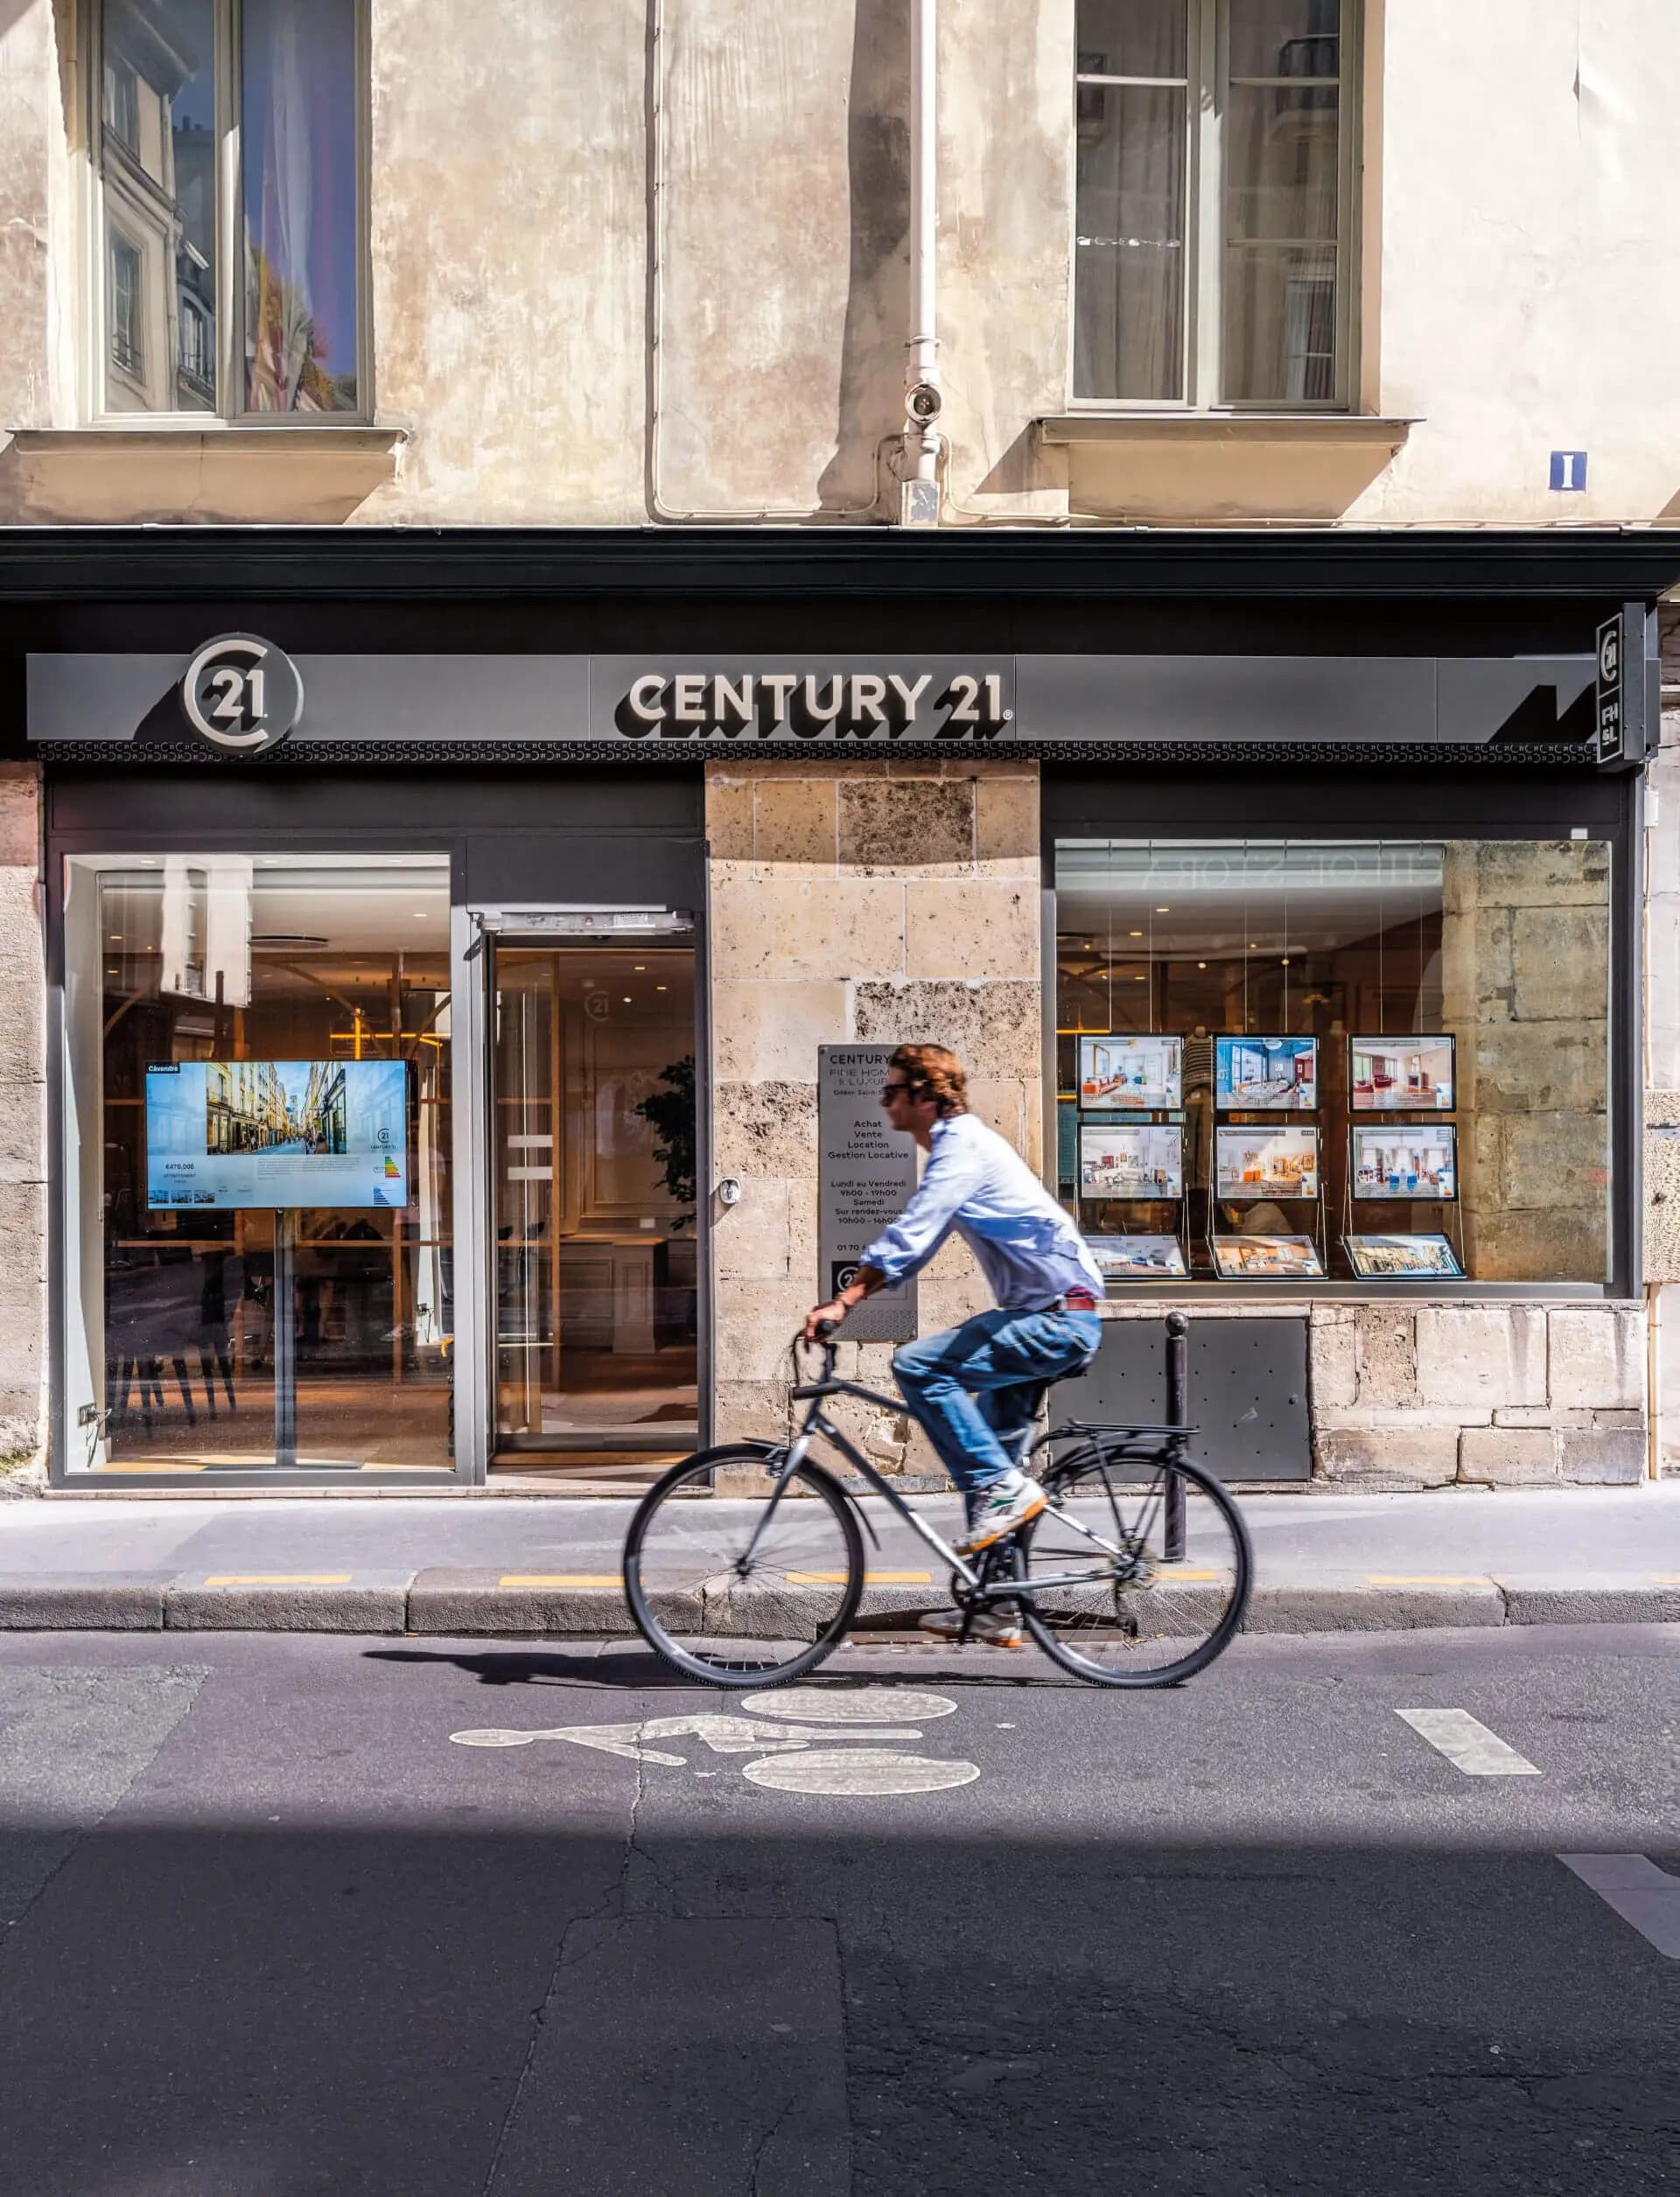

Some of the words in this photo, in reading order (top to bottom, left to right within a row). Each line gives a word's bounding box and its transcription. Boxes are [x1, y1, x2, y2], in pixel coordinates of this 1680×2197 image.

[629, 674, 933, 721] CENTURY
[830, 1054, 891, 1065] CENTURY
[861, 1068, 890, 1077] HOM
[828, 1151, 865, 1159] Gestion
[868, 1151, 909, 1159] Locative
[830, 1179, 854, 1188] Lundi
[868, 1179, 906, 1188] Vendredi
